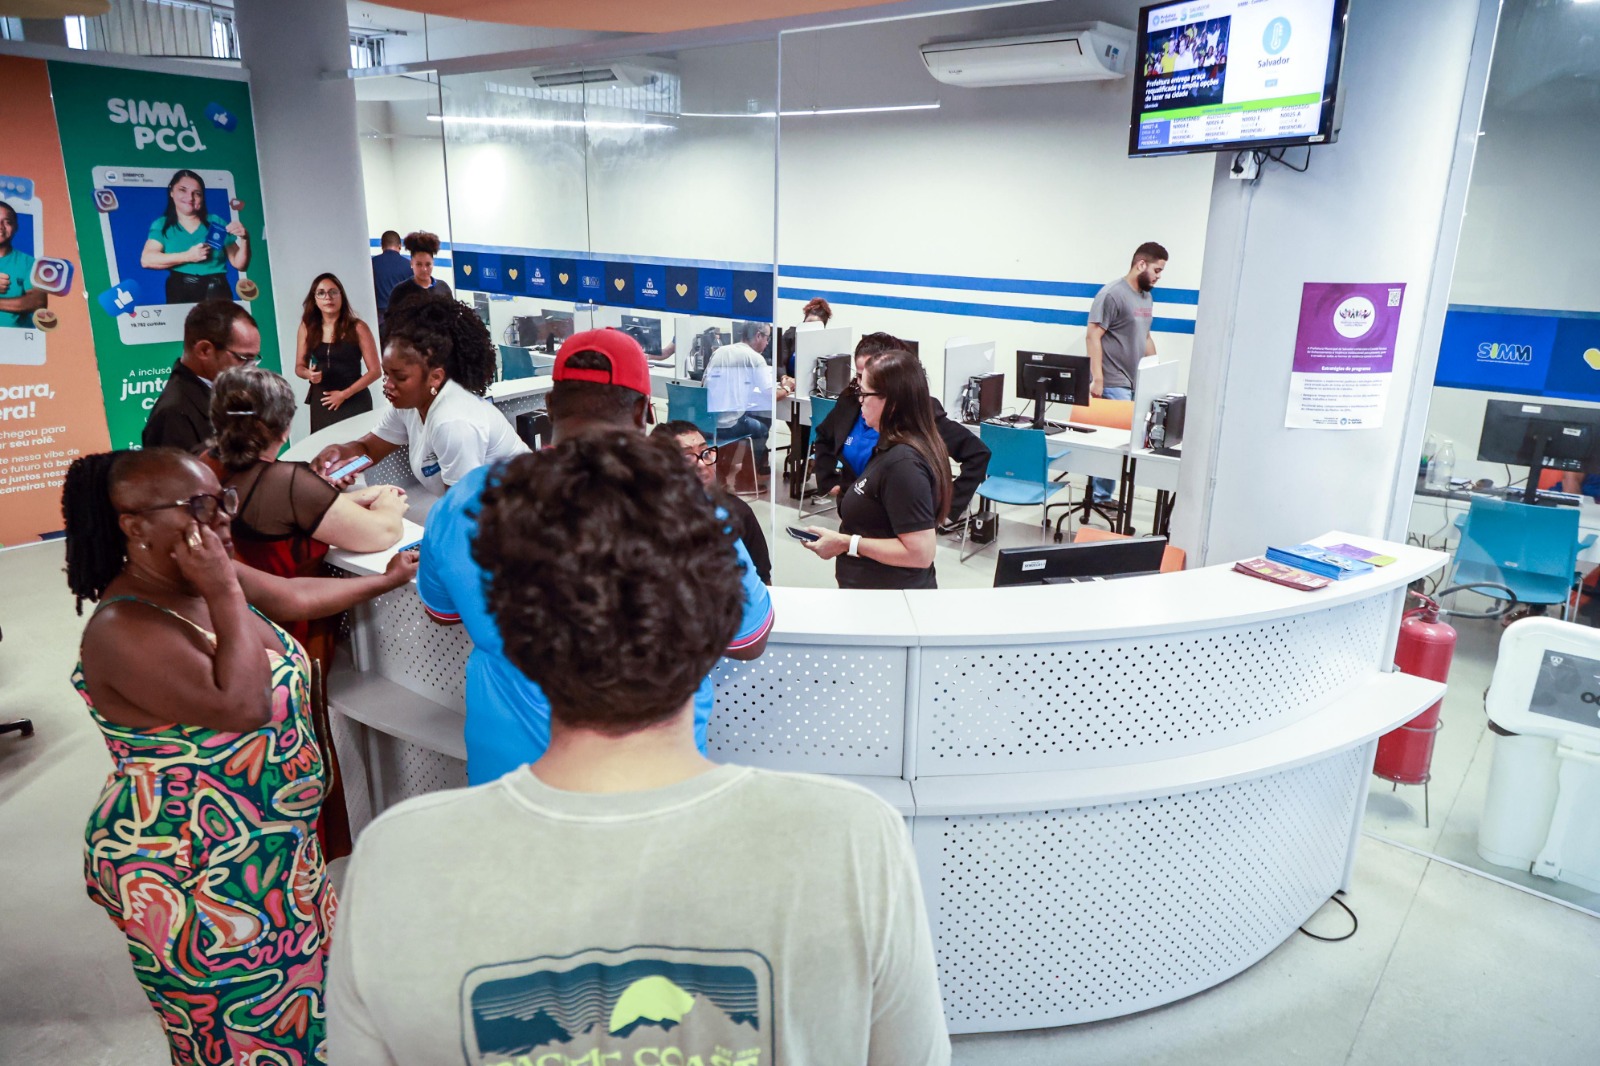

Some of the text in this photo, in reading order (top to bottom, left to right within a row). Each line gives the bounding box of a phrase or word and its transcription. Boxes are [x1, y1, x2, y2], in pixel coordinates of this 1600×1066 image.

[1257, 57, 1290, 68] Salvador
[1146, 72, 1206, 88] Prefeitura entrega praça
[1145, 84, 1176, 95] requalificada
[1200, 78, 1219, 88] opções
[1172, 90, 1188, 98] cidade
[107, 98, 188, 128] SIMM
[704, 286, 726, 298] SIMM
[1477, 342, 1532, 362] SIMM
[138, 366, 172, 376] inclusã
[0, 401, 36, 420] ra!
[41, 426, 66, 436] para
[10, 440, 30, 448] seu
[12, 454, 41, 463] nessa
[44, 450, 64, 458] vibe
[11, 464, 40, 474] futuro
[8, 474, 40, 486] juntos
[0, 482, 46, 494] carreiras
